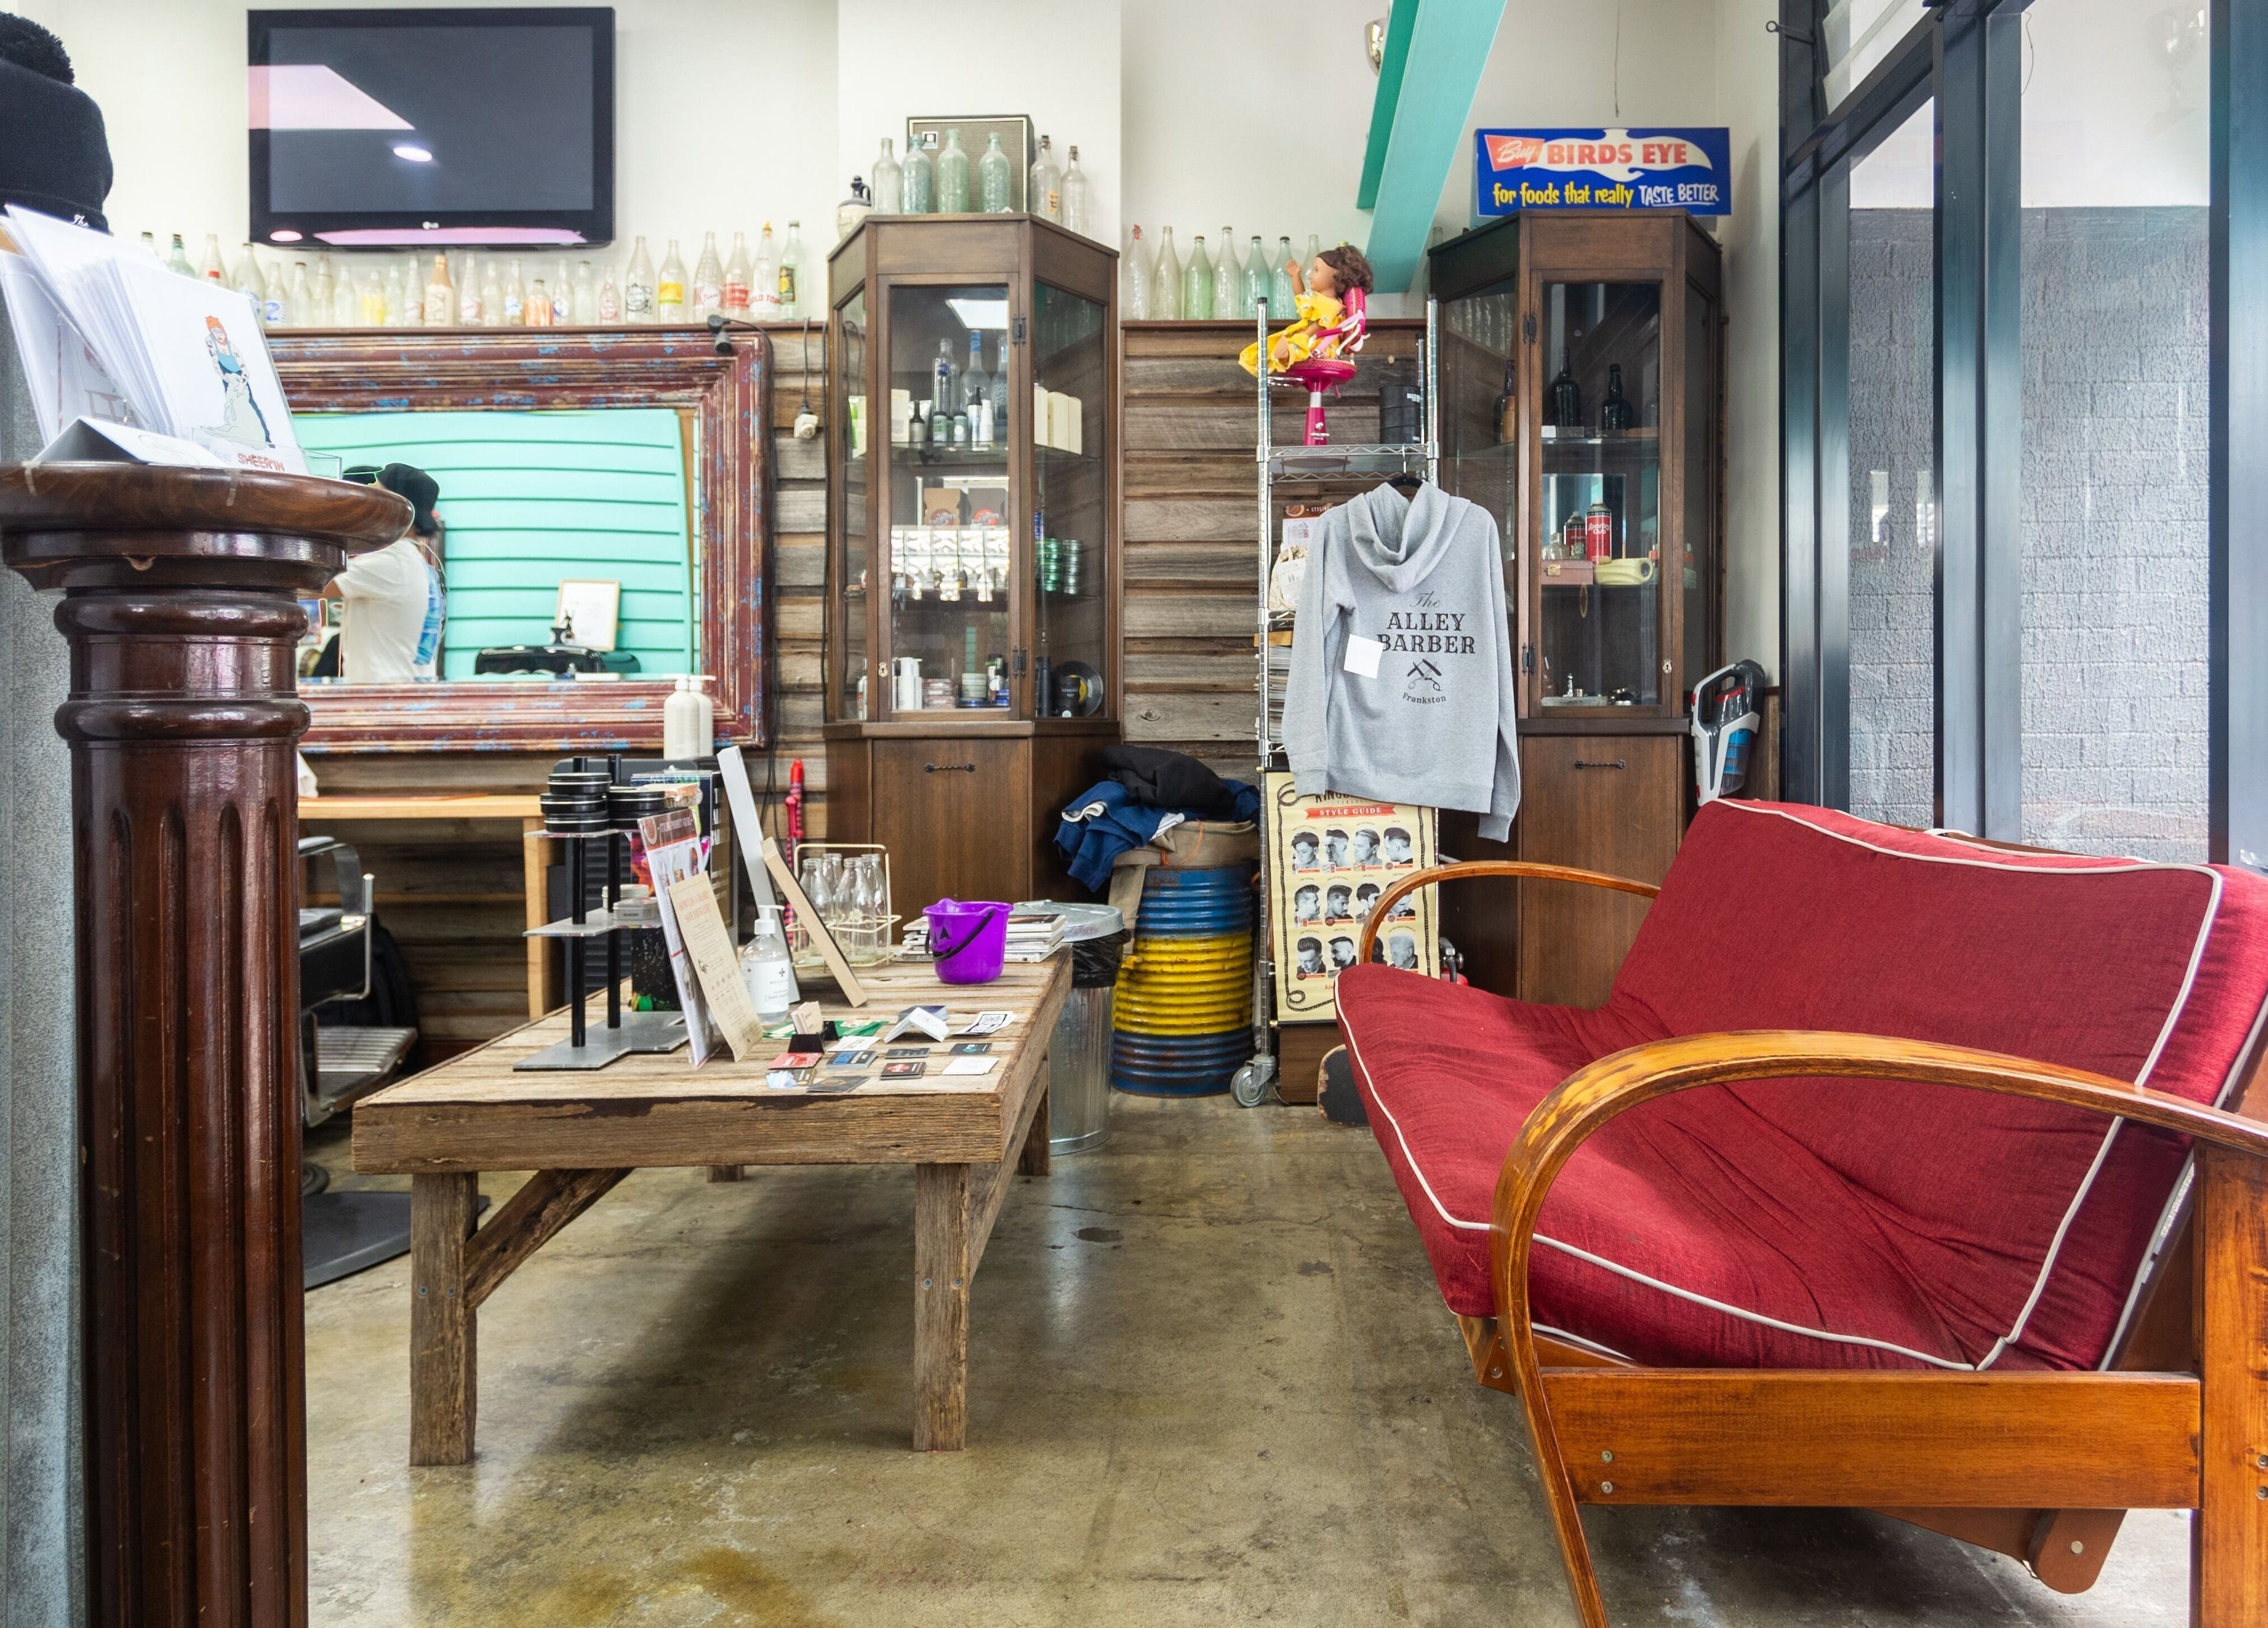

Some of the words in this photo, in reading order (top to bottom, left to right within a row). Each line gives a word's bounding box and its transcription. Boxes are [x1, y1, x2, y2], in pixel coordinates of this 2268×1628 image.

[1497, 140, 1536, 163] Buy
[1547, 144, 1632, 164] BIRDS
[1643, 144, 1687, 164] EYE
[1493, 182, 1516, 207] for
[1520, 182, 1560, 207] foods
[1564, 181, 1590, 204] that
[1595, 183, 1634, 209] really
[1638, 185, 1675, 207] TASTE
[1677, 183, 1720, 202] BETTER
[1409, 591, 1441, 608] The
[1386, 612, 1466, 631] ALLEY
[1376, 634, 1475, 654] BARBER
[1402, 692, 1446, 704] Frankston
